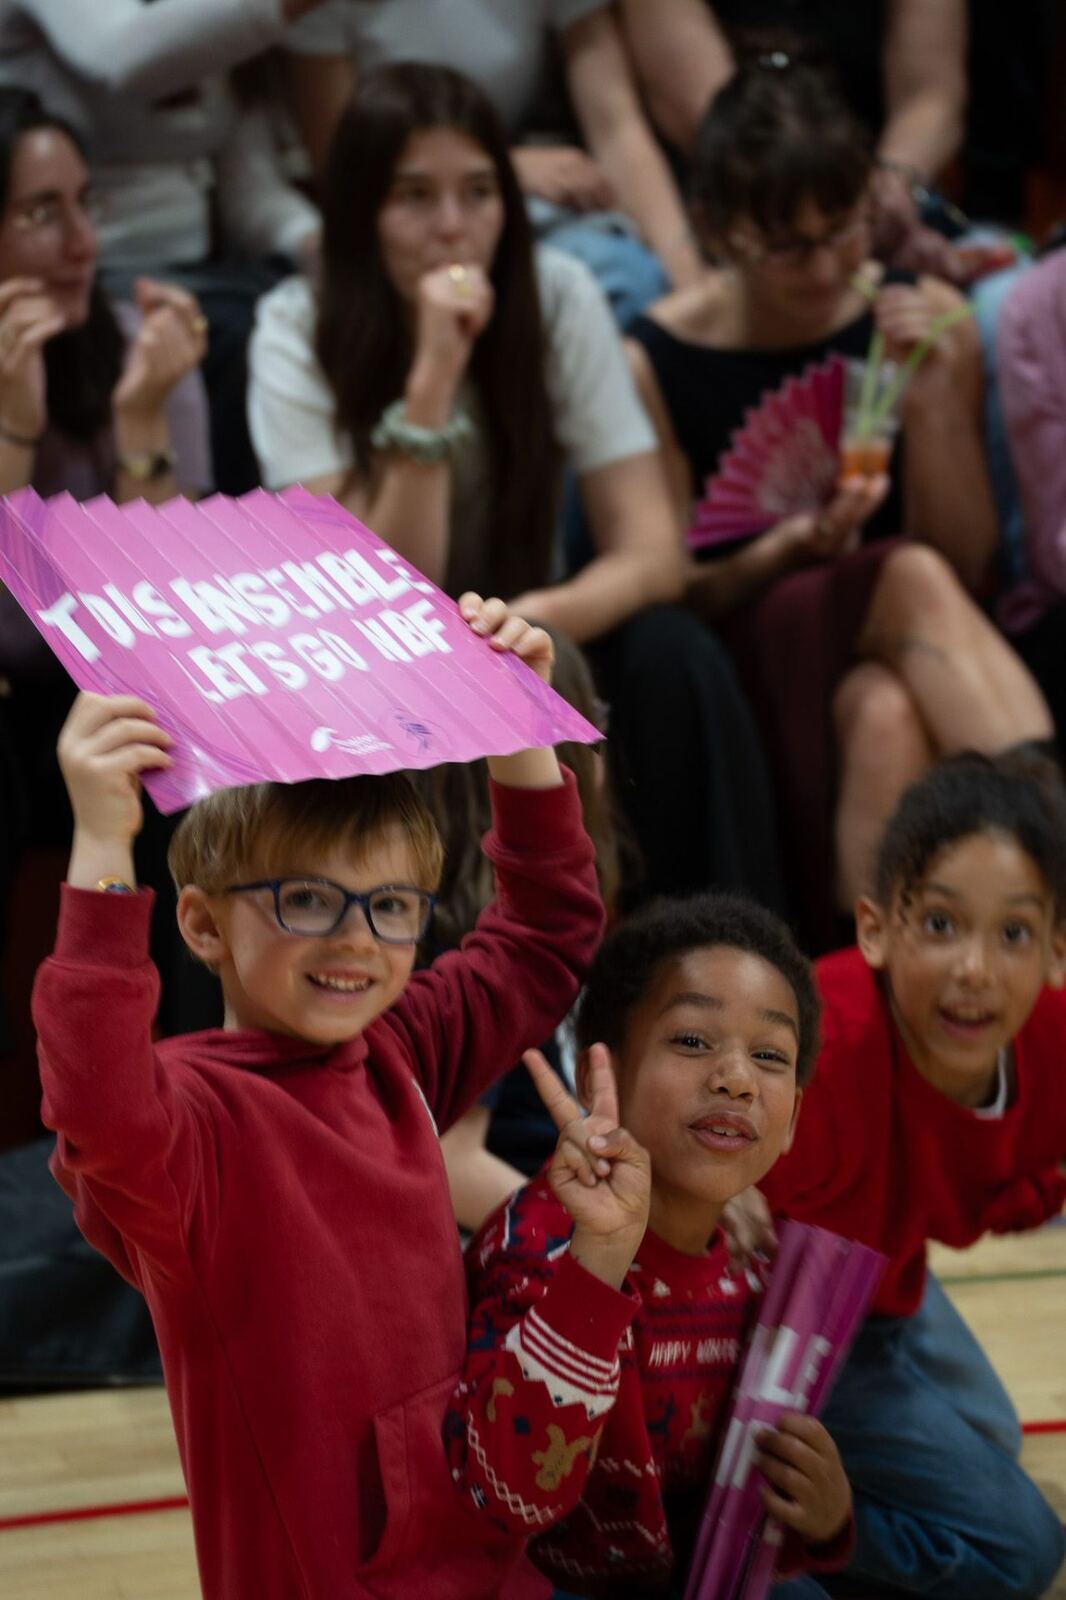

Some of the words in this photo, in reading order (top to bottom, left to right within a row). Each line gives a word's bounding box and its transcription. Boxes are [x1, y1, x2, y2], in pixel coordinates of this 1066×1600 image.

[36, 579, 194, 663] TOUS
[287, 626, 371, 683] GO
[349, 598, 454, 663] NBF
[648, 1340, 692, 1368] HAPPY
